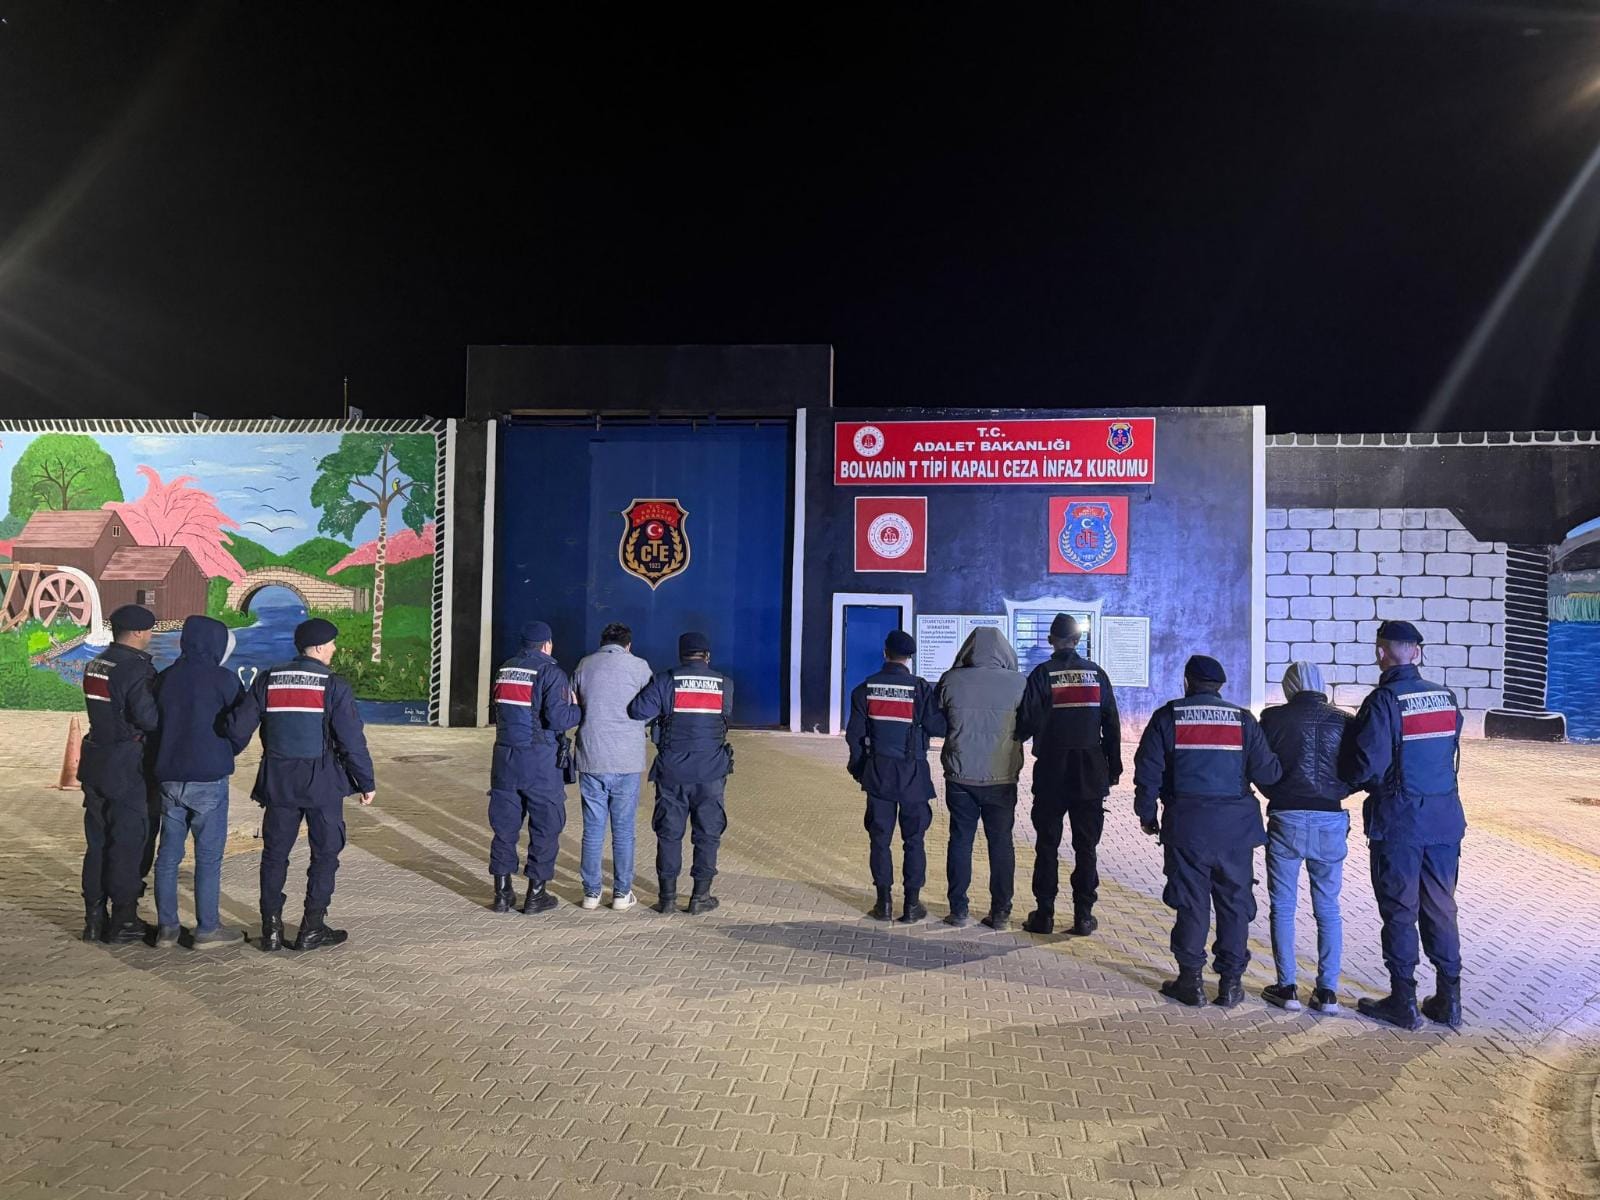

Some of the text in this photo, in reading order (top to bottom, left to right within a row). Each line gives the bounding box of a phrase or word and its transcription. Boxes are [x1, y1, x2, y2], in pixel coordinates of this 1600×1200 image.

[977, 427, 1006, 438] T.C.
[913, 438, 1071, 452] ADALET BAKANLIĞI
[840, 455, 1149, 478] BOLVADİN T TİPİ KAPALI CEZA İNFAZ KURUMU
[680, 679, 719, 690] JANDARMA
[1405, 695, 1452, 711] JANDARMA
[1180, 709, 1236, 721] JANDARMA
